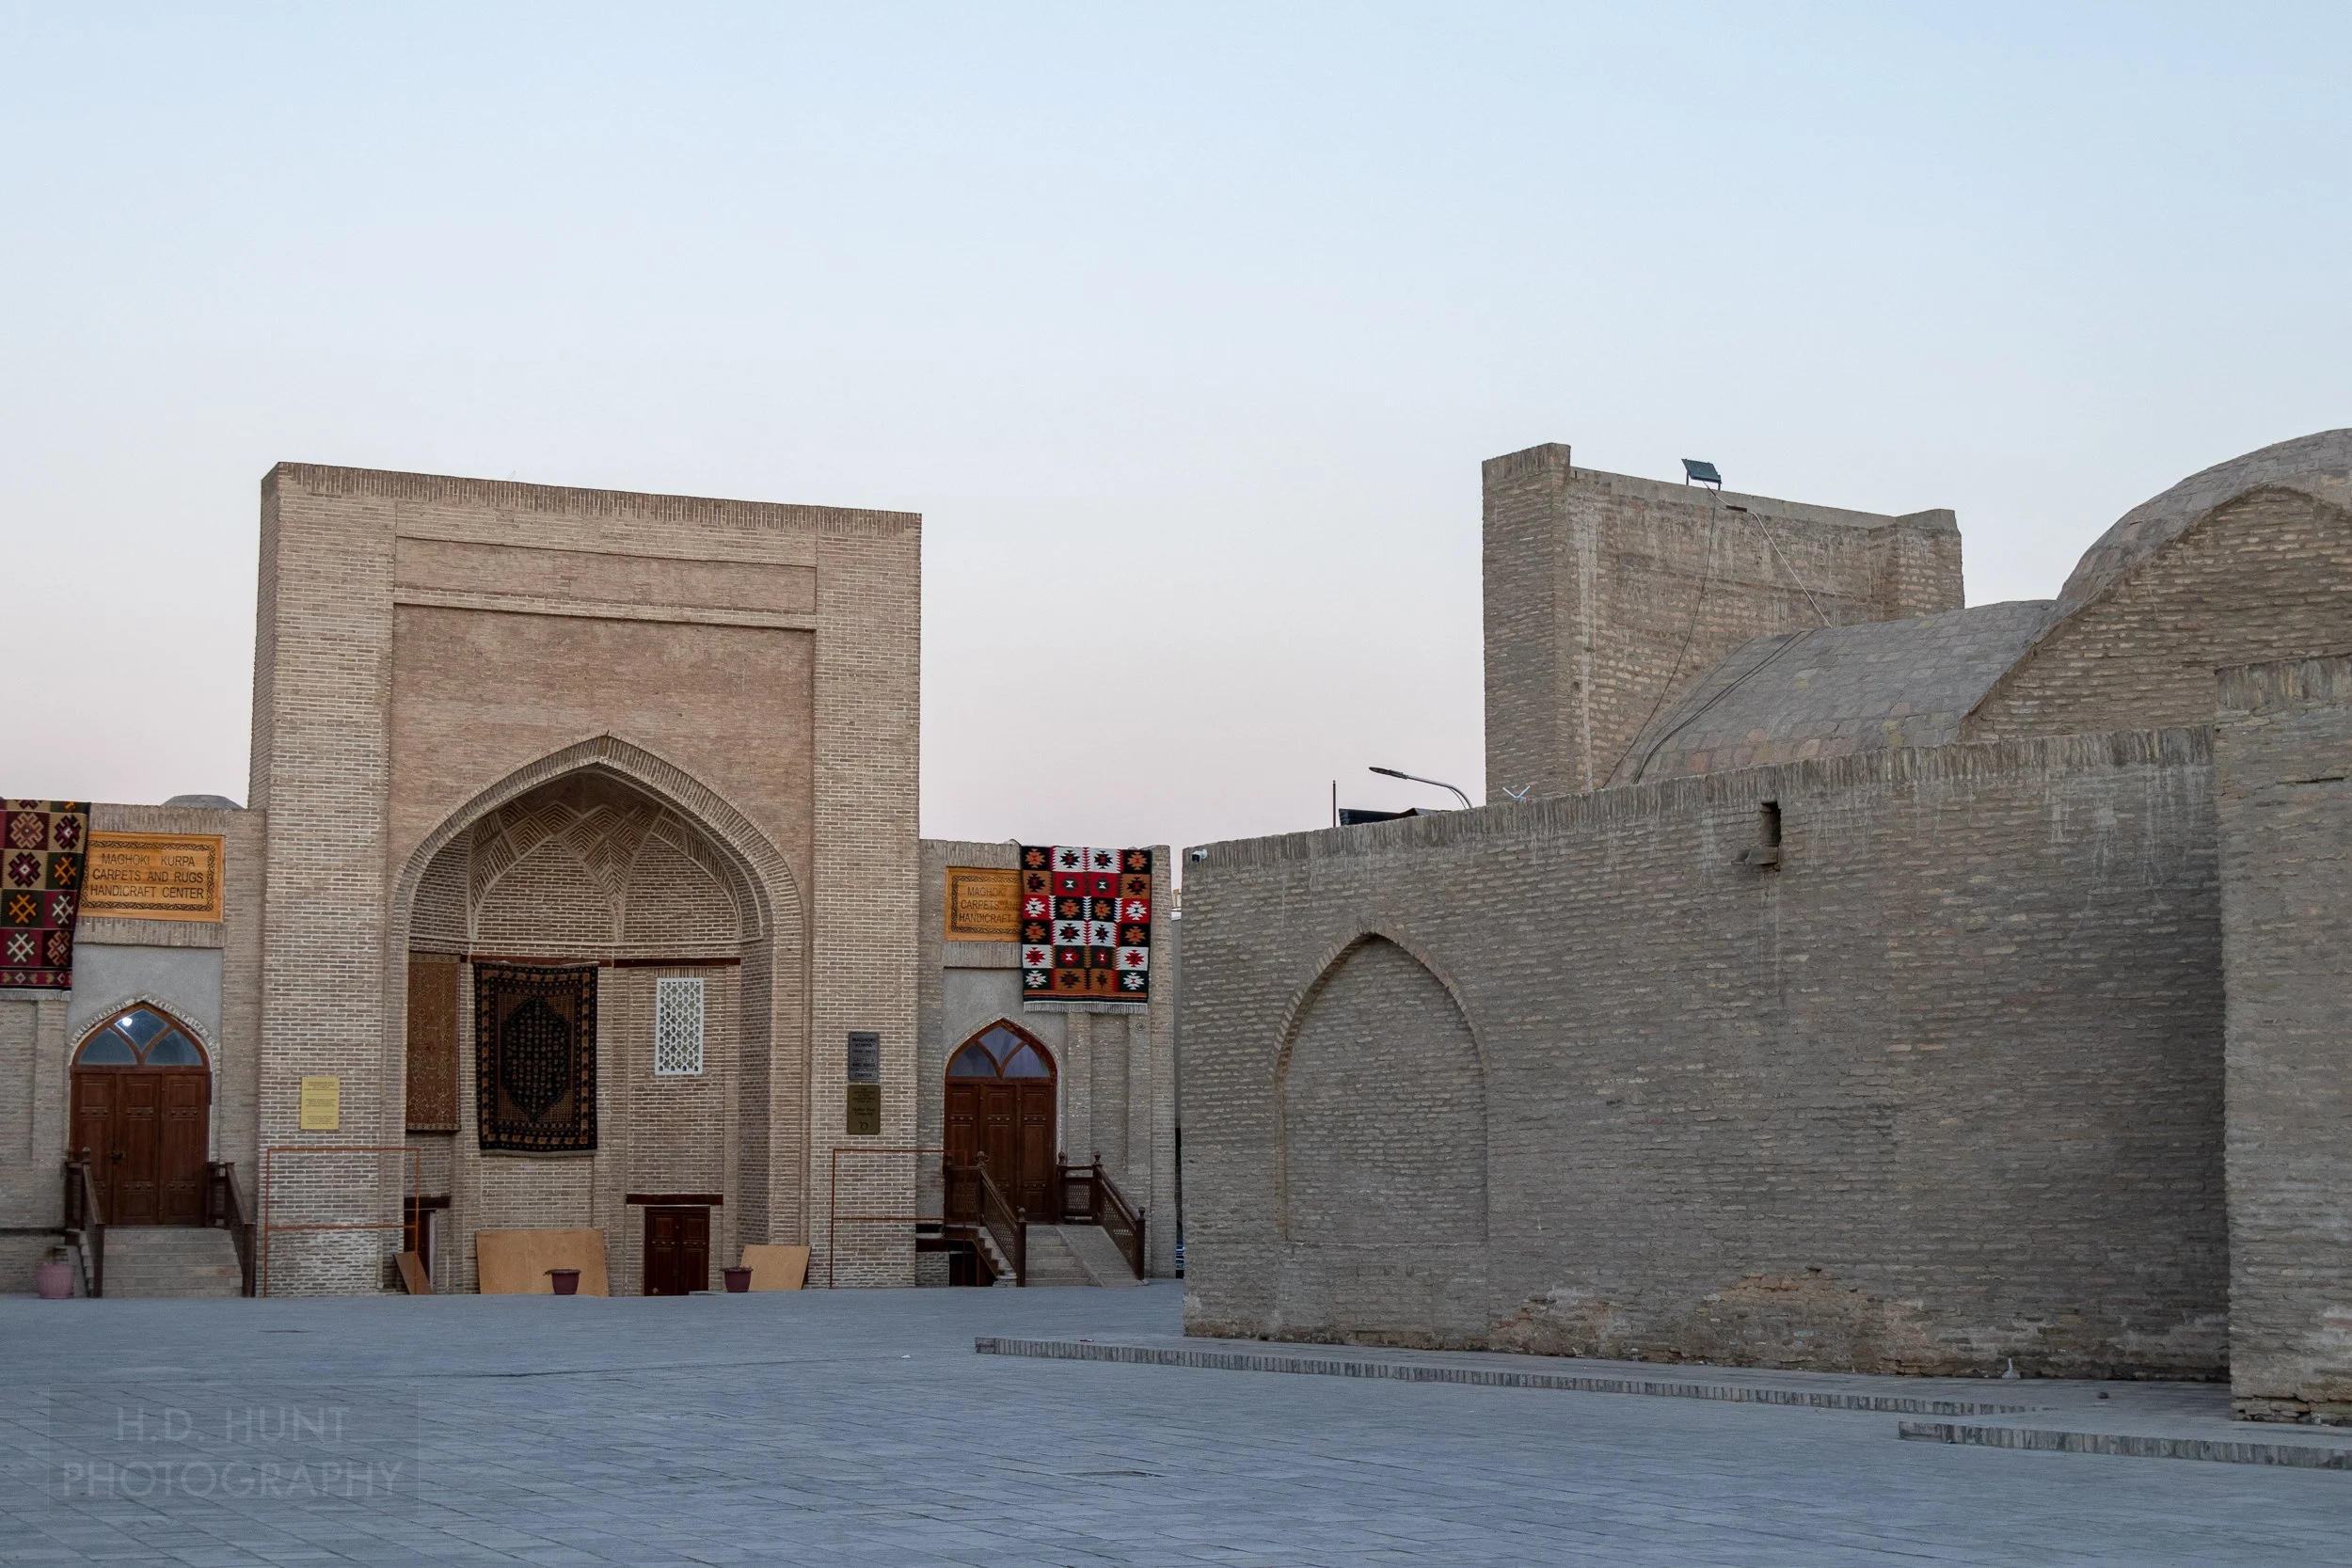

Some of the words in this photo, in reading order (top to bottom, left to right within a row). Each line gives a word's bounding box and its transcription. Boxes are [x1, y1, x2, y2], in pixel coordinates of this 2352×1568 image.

[102, 853, 151, 865] MAGHOKI
[161, 855, 196, 867] KURPA
[92, 868, 141, 881] CARPETS
[147, 871, 169, 881] AND
[174, 872, 204, 883] RUGS
[90, 884, 156, 897] HANDICRAFT
[162, 886, 204, 899] CENTER
[961, 899, 1000, 911] CARPETS
[959, 912, 1012, 924] HANDICRAFT
